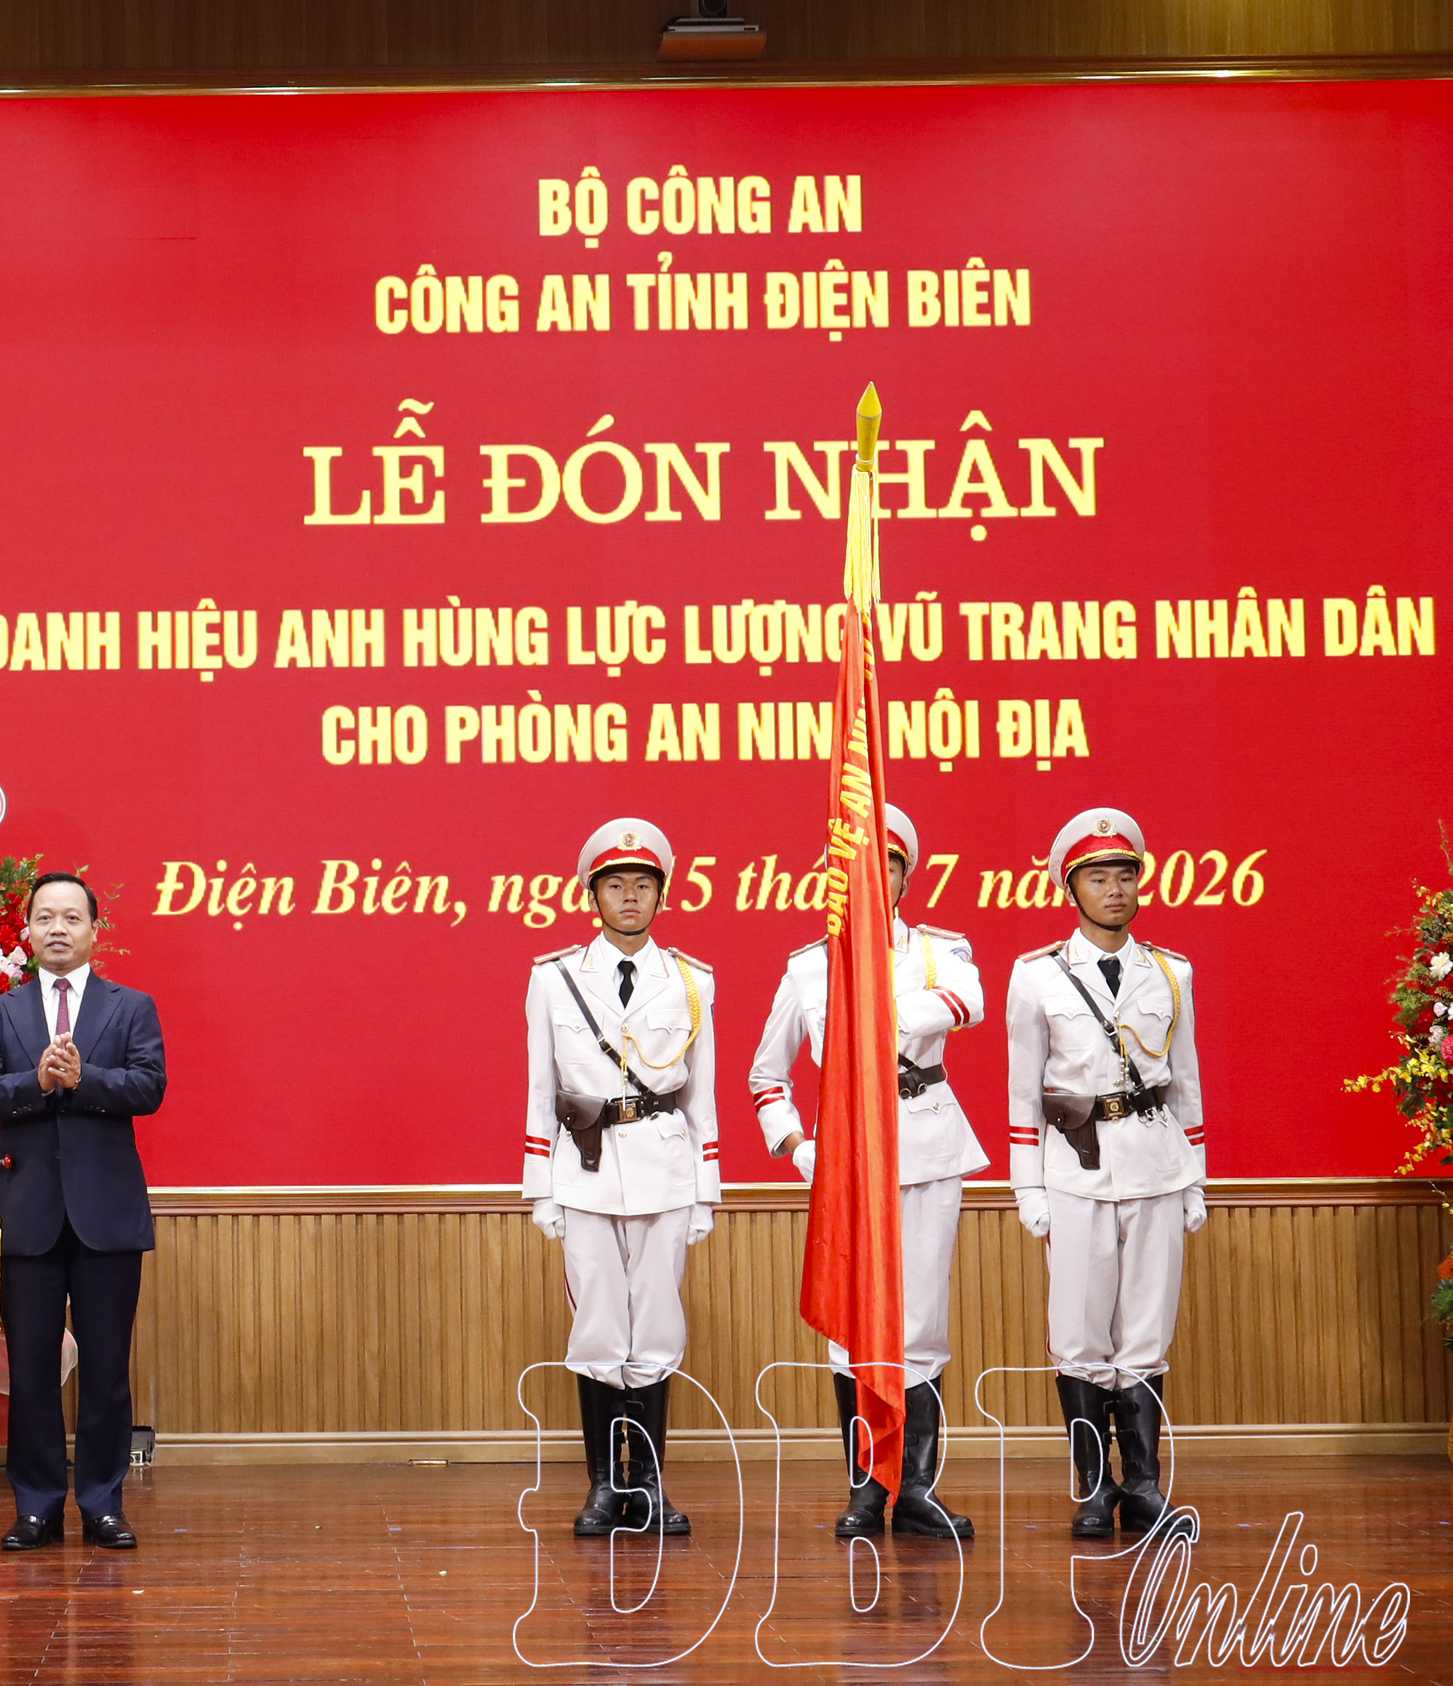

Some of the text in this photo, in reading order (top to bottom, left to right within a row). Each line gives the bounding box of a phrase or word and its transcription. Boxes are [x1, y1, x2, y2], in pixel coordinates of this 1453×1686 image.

[539, 165, 862, 248] BỘ CÔNG AN
[376, 251, 1030, 341] CÔNG AN TỈNH ĐIỆN BIÊN
[303, 399, 1104, 541] LỄ ĐÓN NHẬN
[138, 598, 257, 682] HIỆU
[274, 609, 384, 668] ANH
[404, 596, 548, 667] HÙNG
[567, 601, 666, 677] LỰC
[876, 591, 943, 662] VŨ
[959, 600, 1136, 661] TRANG
[1156, 586, 1305, 658] NHÂN
[1324, 585, 1434, 656] DÂN
[322, 705, 428, 765] CHO
[446, 690, 627, 763] PHÒNG
[646, 703, 720, 761] AN
[738, 702, 833, 760] NIN
[888, 688, 979, 771] NỘI
[997, 699, 1089, 770] ĐỊA
[840, 762, 873, 819] AN
[152, 860, 295, 930] Điện
[312, 858, 466, 927] Biên,
[736, 854, 829, 911] thá
[926, 854, 959, 908] 7
